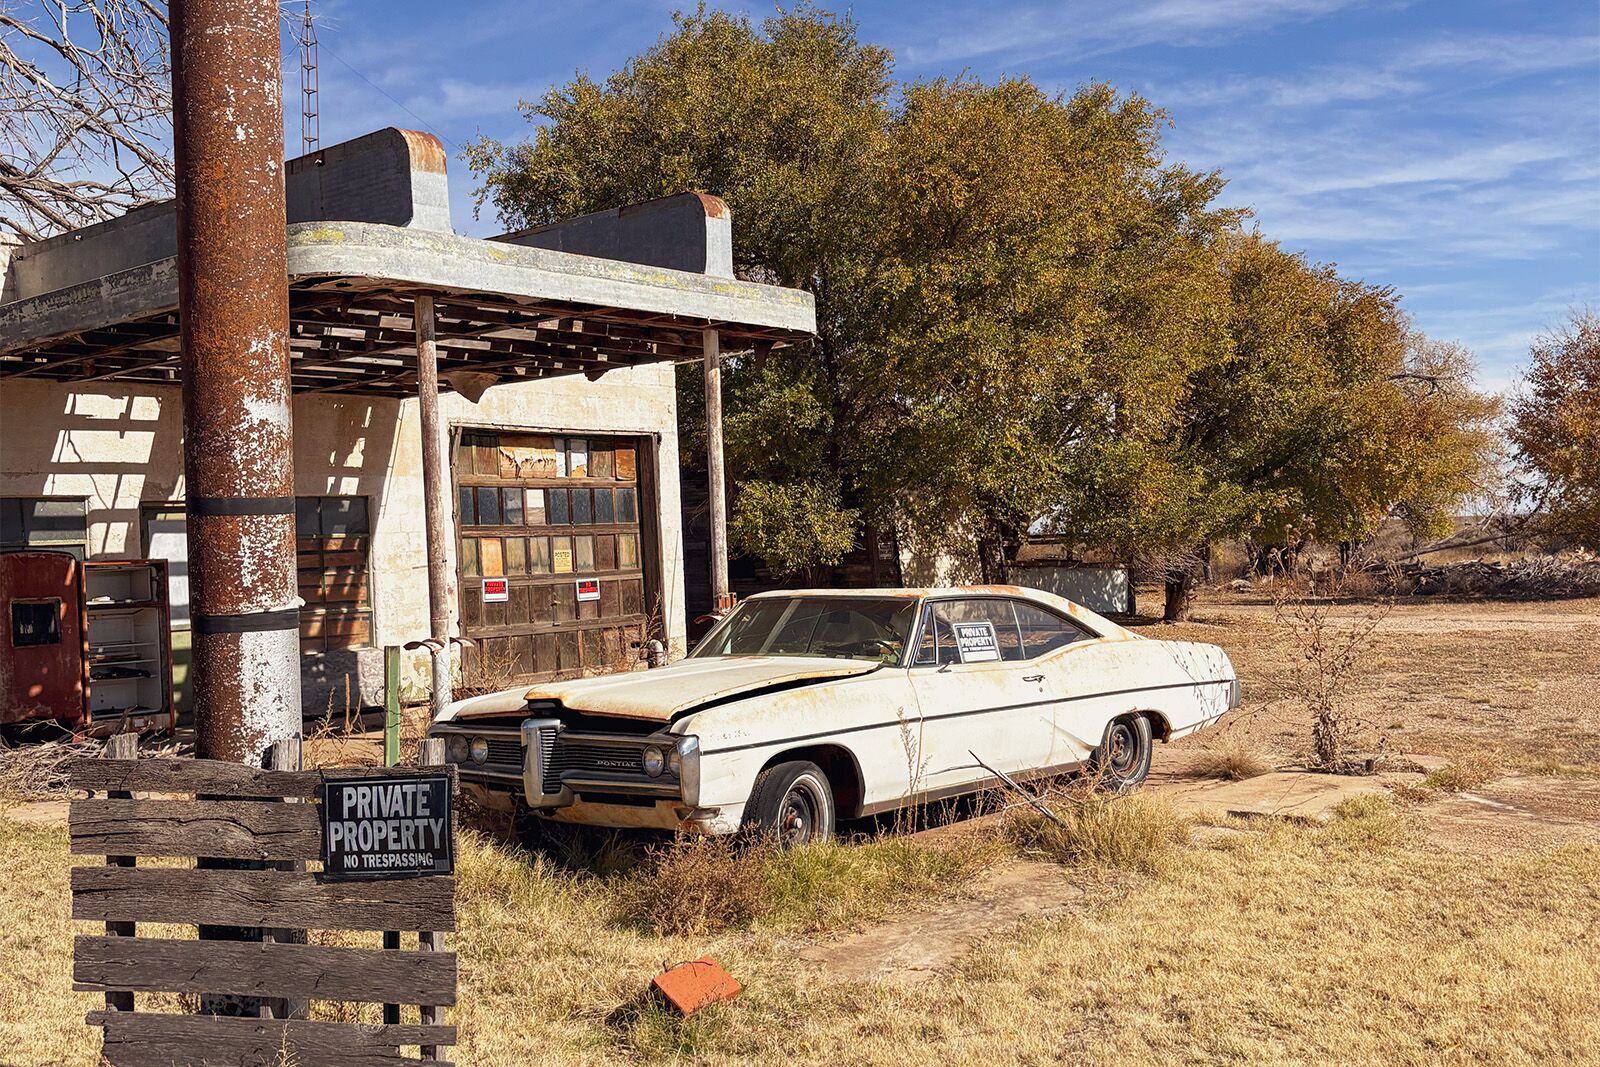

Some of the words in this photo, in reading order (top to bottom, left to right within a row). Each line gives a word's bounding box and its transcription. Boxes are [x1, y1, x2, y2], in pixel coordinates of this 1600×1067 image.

[961, 627, 988, 637] PRIVATE
[960, 636, 993, 647] PROPERTY
[343, 784, 430, 819] PRIVATE
[330, 818, 444, 852] PROPERTY
[344, 855, 358, 868] NO
[362, 852, 434, 868] TRESPASSING
